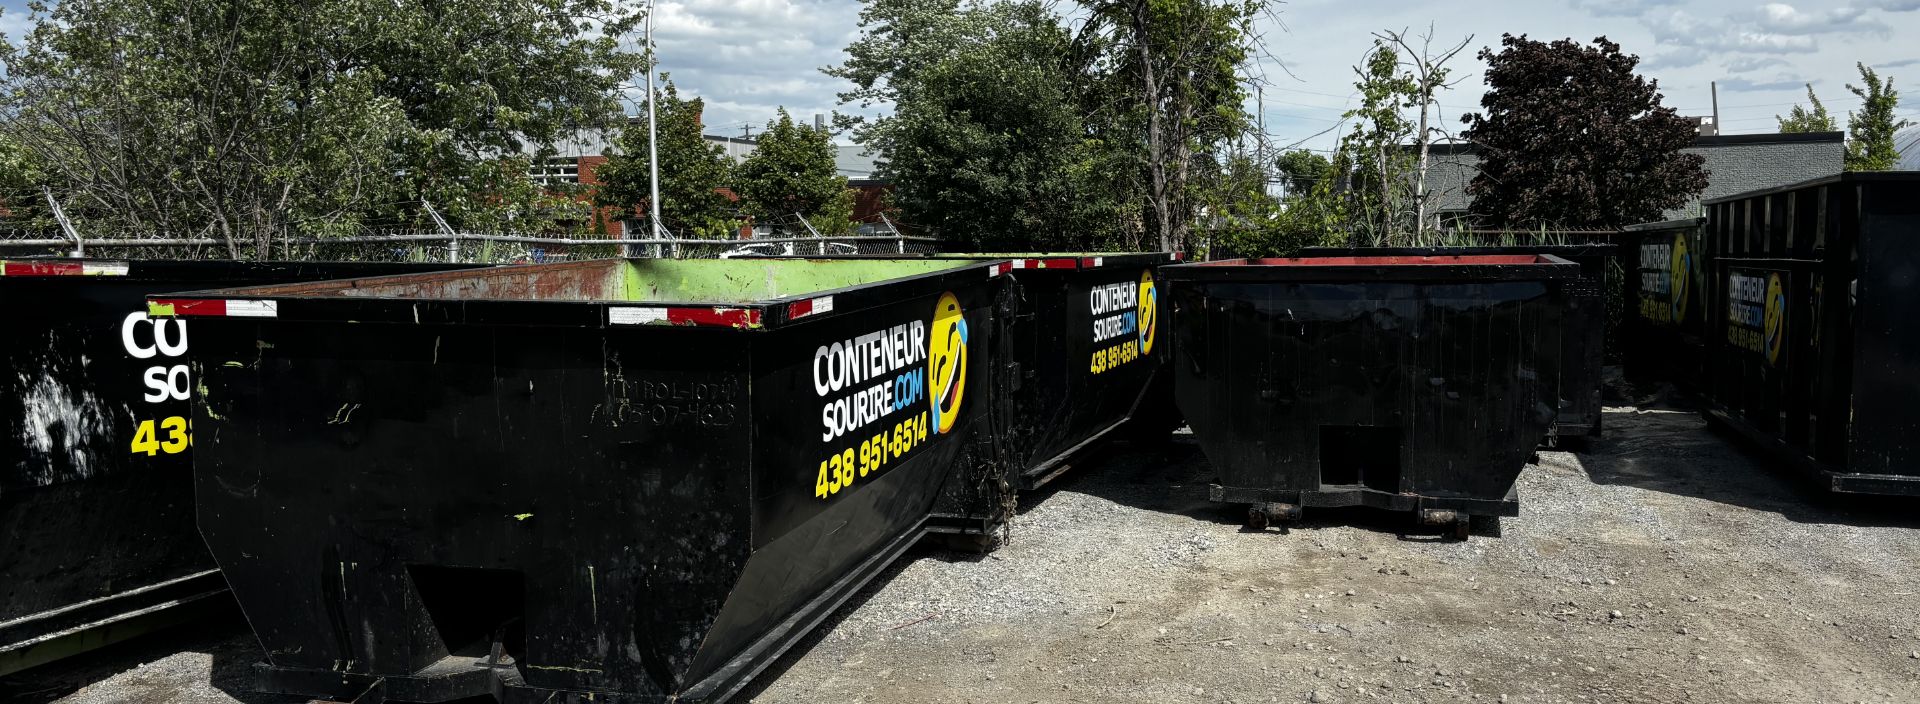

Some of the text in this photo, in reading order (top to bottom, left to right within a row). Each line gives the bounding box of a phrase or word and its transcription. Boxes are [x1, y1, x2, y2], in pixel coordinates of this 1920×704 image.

[1640, 243, 1671, 271] CONTENEUR
[1090, 280, 1137, 316] CONTENEUR
[1729, 273, 1765, 304] CONTENEUR
[1093, 310, 1136, 343] SOURIRE.COM
[813, 319, 927, 397] CONTENEUR
[1090, 338, 1138, 375] 438 951-6514
[822, 366, 923, 443] SOURIRE.COM
[131, 416, 194, 457] 43
[815, 411, 927, 500] 438 951-6514
